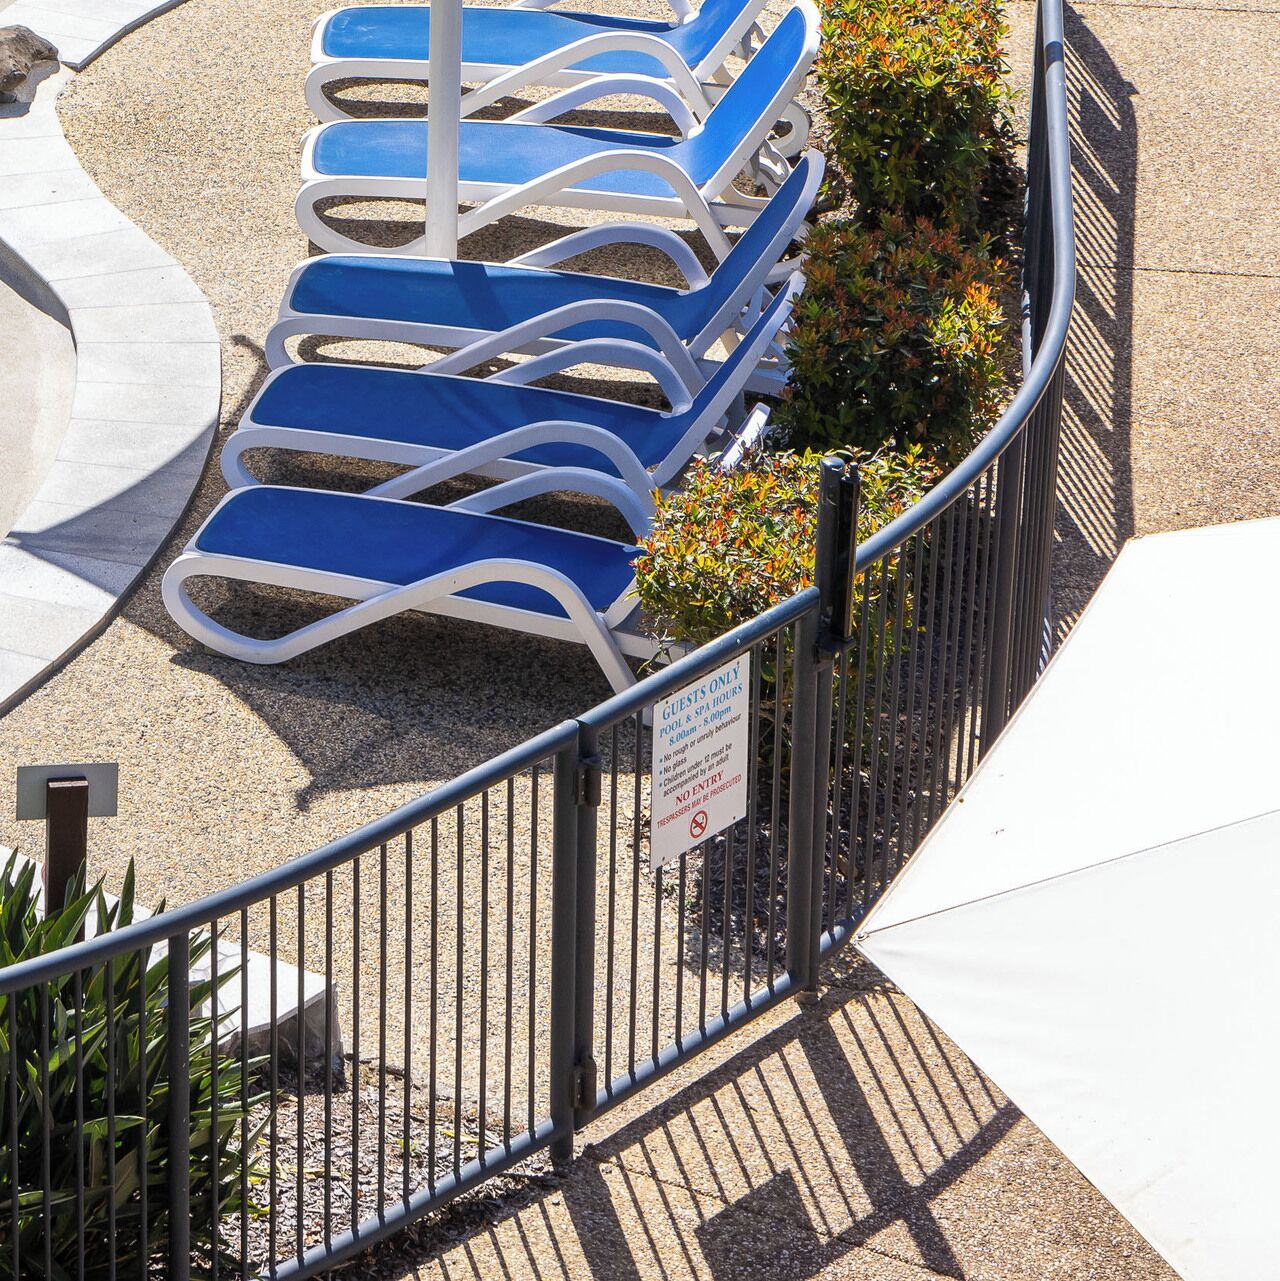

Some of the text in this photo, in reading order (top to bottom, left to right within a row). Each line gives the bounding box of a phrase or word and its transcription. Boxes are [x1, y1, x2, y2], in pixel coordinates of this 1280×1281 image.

[659, 682, 743, 738] POOL & SPA HOURS
[662, 665, 740, 720] GUESTS ONLY
[663, 713, 741, 763] No rough or unruly behaviour
[669, 725, 697, 747] 8.00am
[703, 705, 732, 727] 8.00pm
[663, 743, 732, 787] Children under 12 must be
[663, 756, 687, 775] No glass
[663, 754, 729, 797] accompanied by an adult
[657, 774, 742, 829] TRESPASSERS MAY BE PROSECUTED
[675, 770, 724, 806] NO ENTRY
